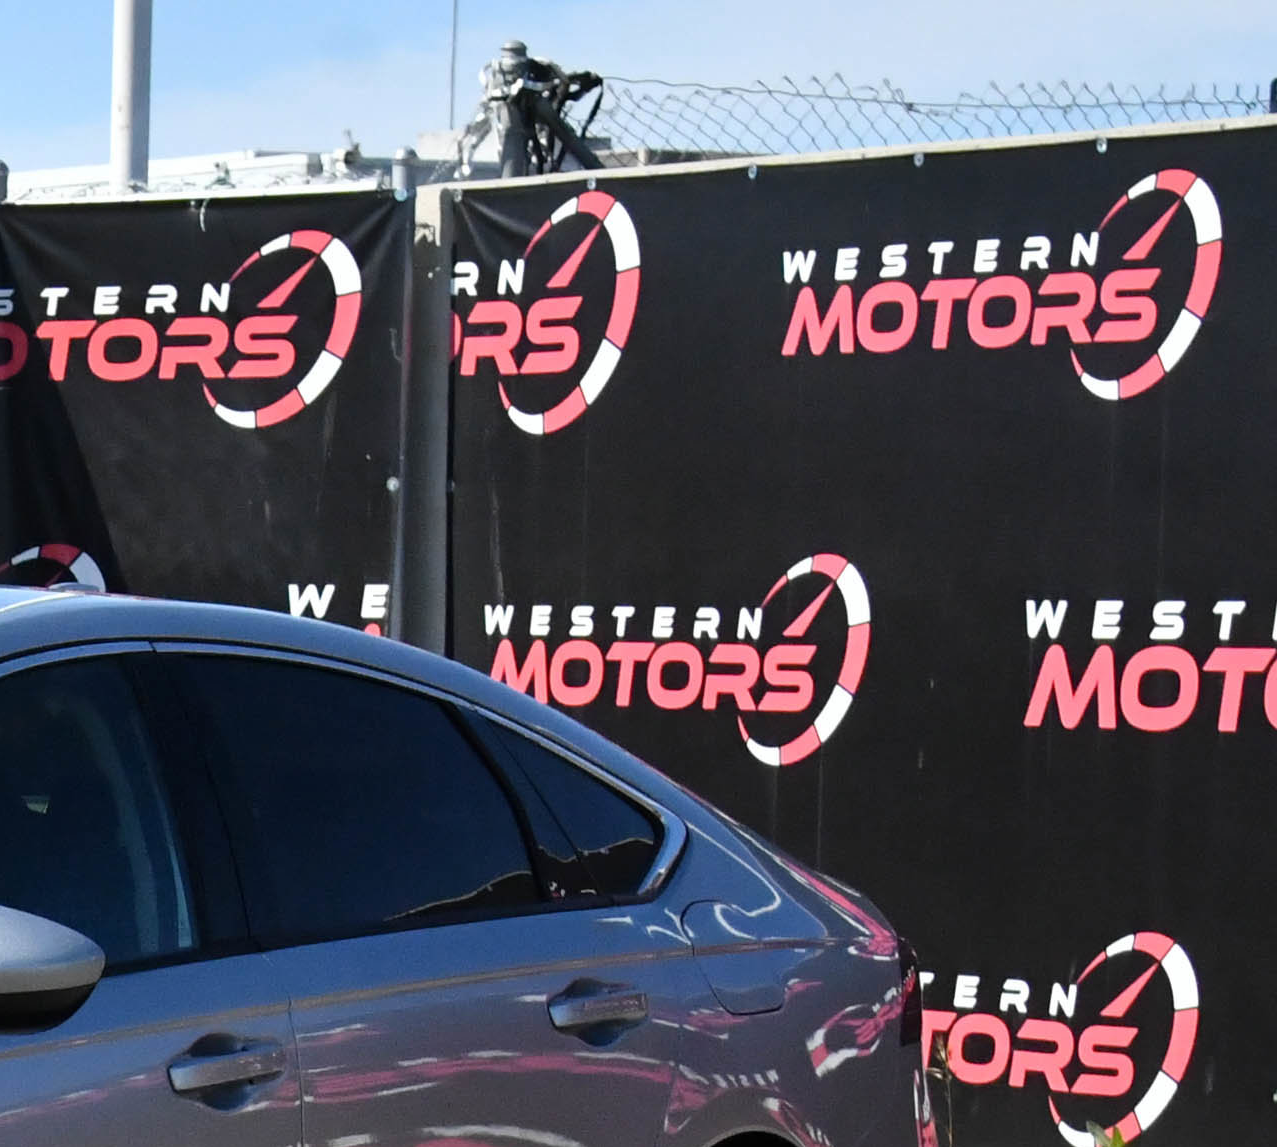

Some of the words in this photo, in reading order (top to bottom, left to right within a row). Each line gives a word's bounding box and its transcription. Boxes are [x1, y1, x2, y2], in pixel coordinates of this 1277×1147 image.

[781, 231, 1101, 286] WESTERN
[450, 295, 584, 377] RS
[780, 267, 1163, 357] MOTORS
[483, 603, 763, 641] WESTERN
[1025, 599, 1277, 642] WEST
[489, 637, 819, 713] MOTORS
[1022, 643, 1277, 734] MOT
